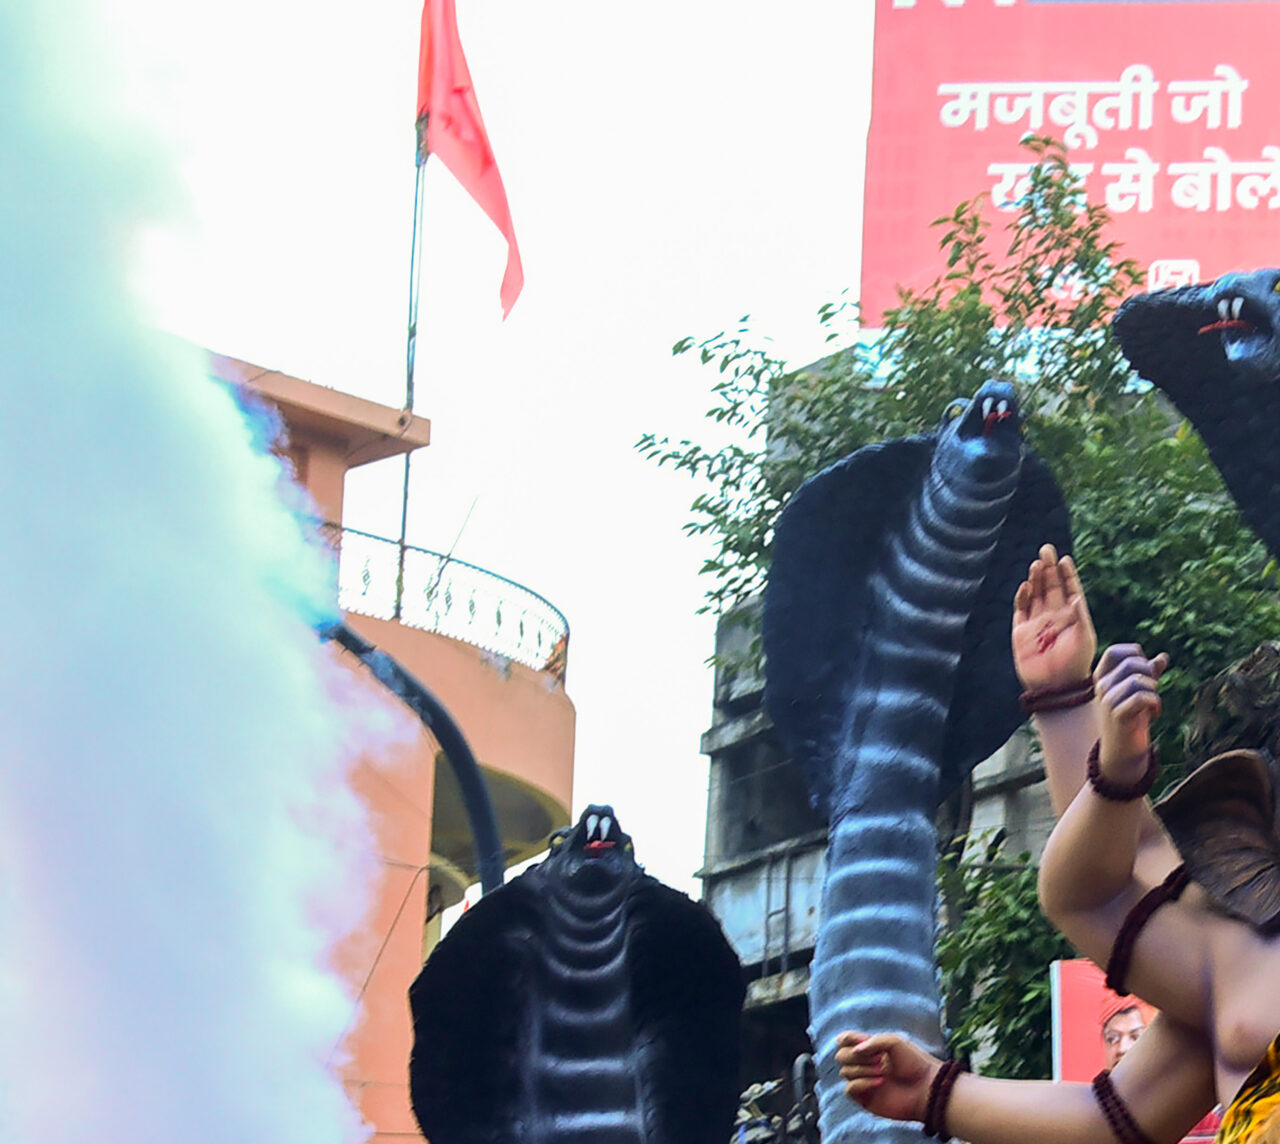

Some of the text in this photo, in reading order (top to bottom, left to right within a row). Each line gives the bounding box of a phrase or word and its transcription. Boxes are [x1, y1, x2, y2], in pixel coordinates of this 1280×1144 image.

[937, 64, 1249, 149] मजबूती जो
[1101, 147, 1160, 213] से
